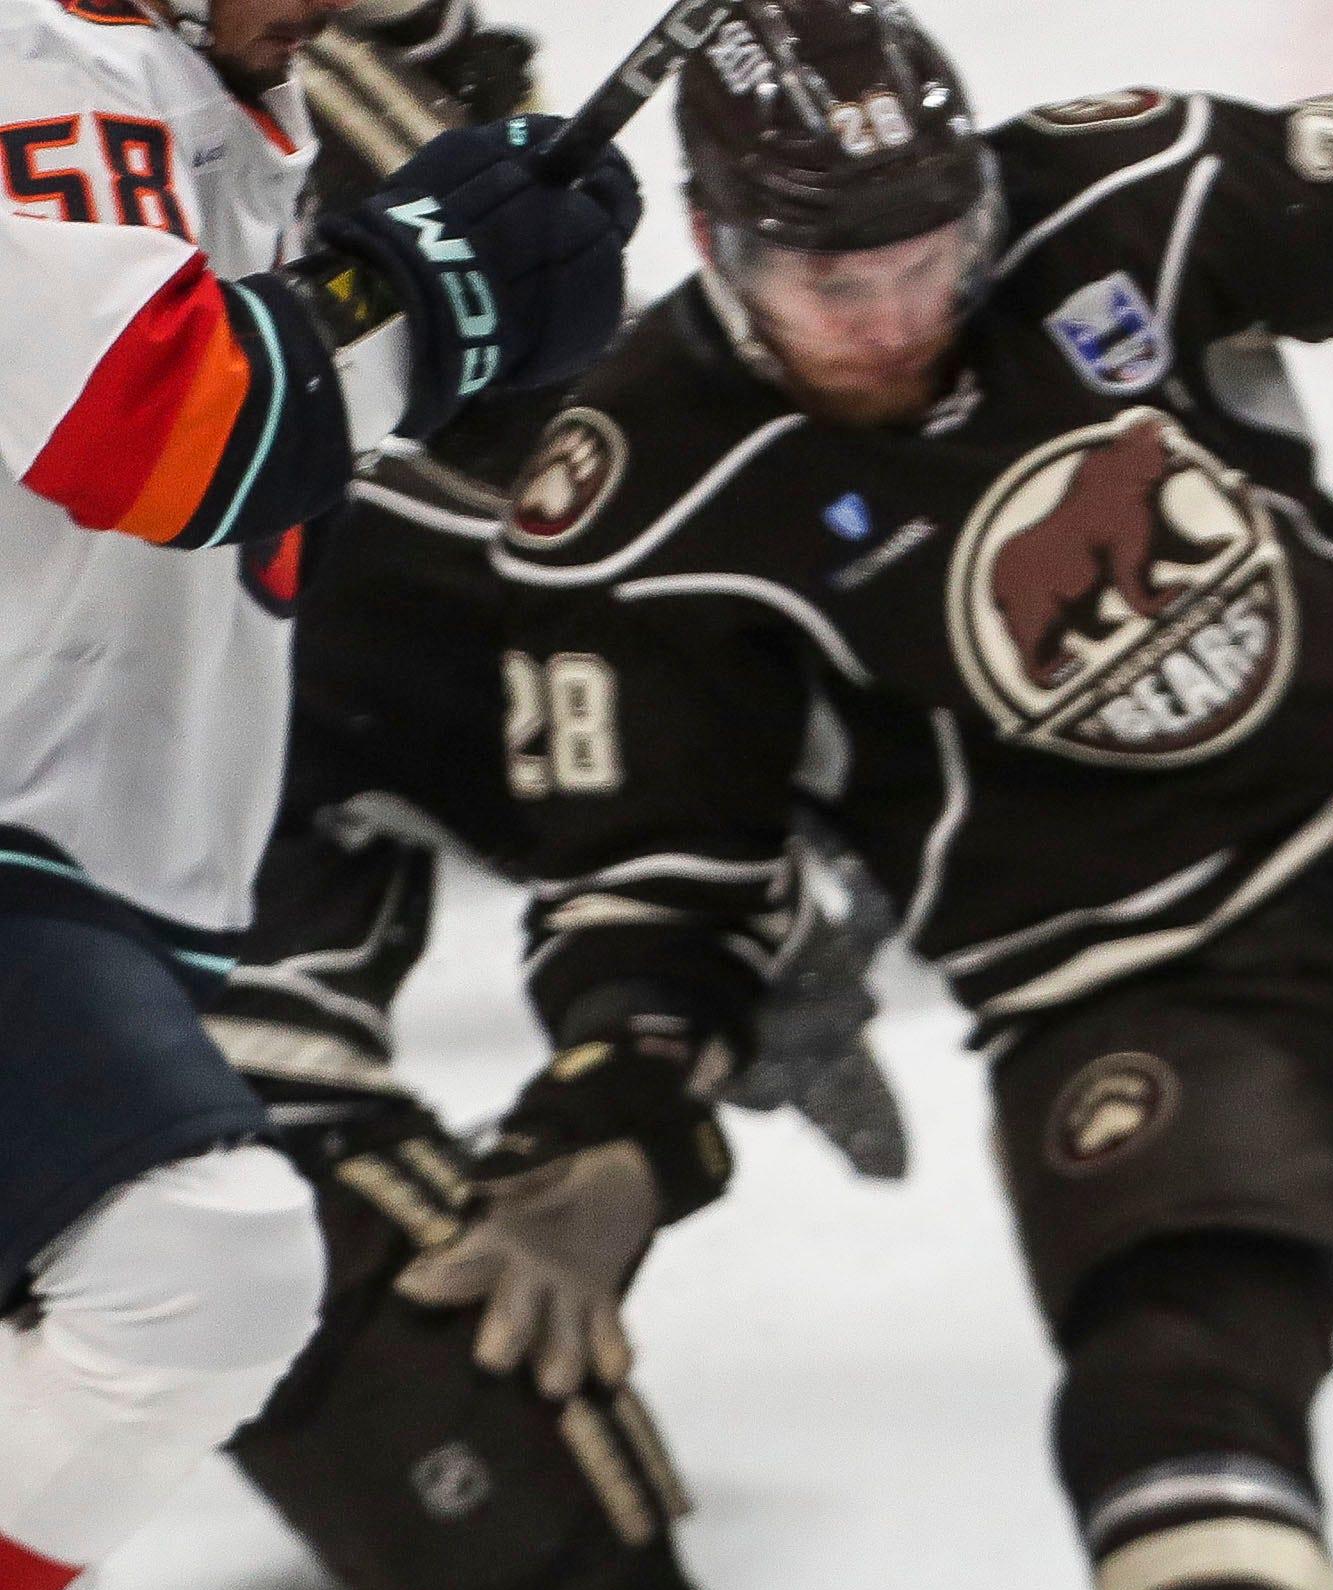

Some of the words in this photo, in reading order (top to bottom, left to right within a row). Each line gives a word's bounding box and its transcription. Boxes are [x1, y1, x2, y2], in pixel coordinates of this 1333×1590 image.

[0, 111, 202, 247] 58
[385, 195, 502, 397] CCM
[501, 650, 627, 799] 28
[1100, 592, 1271, 743] BEARS
